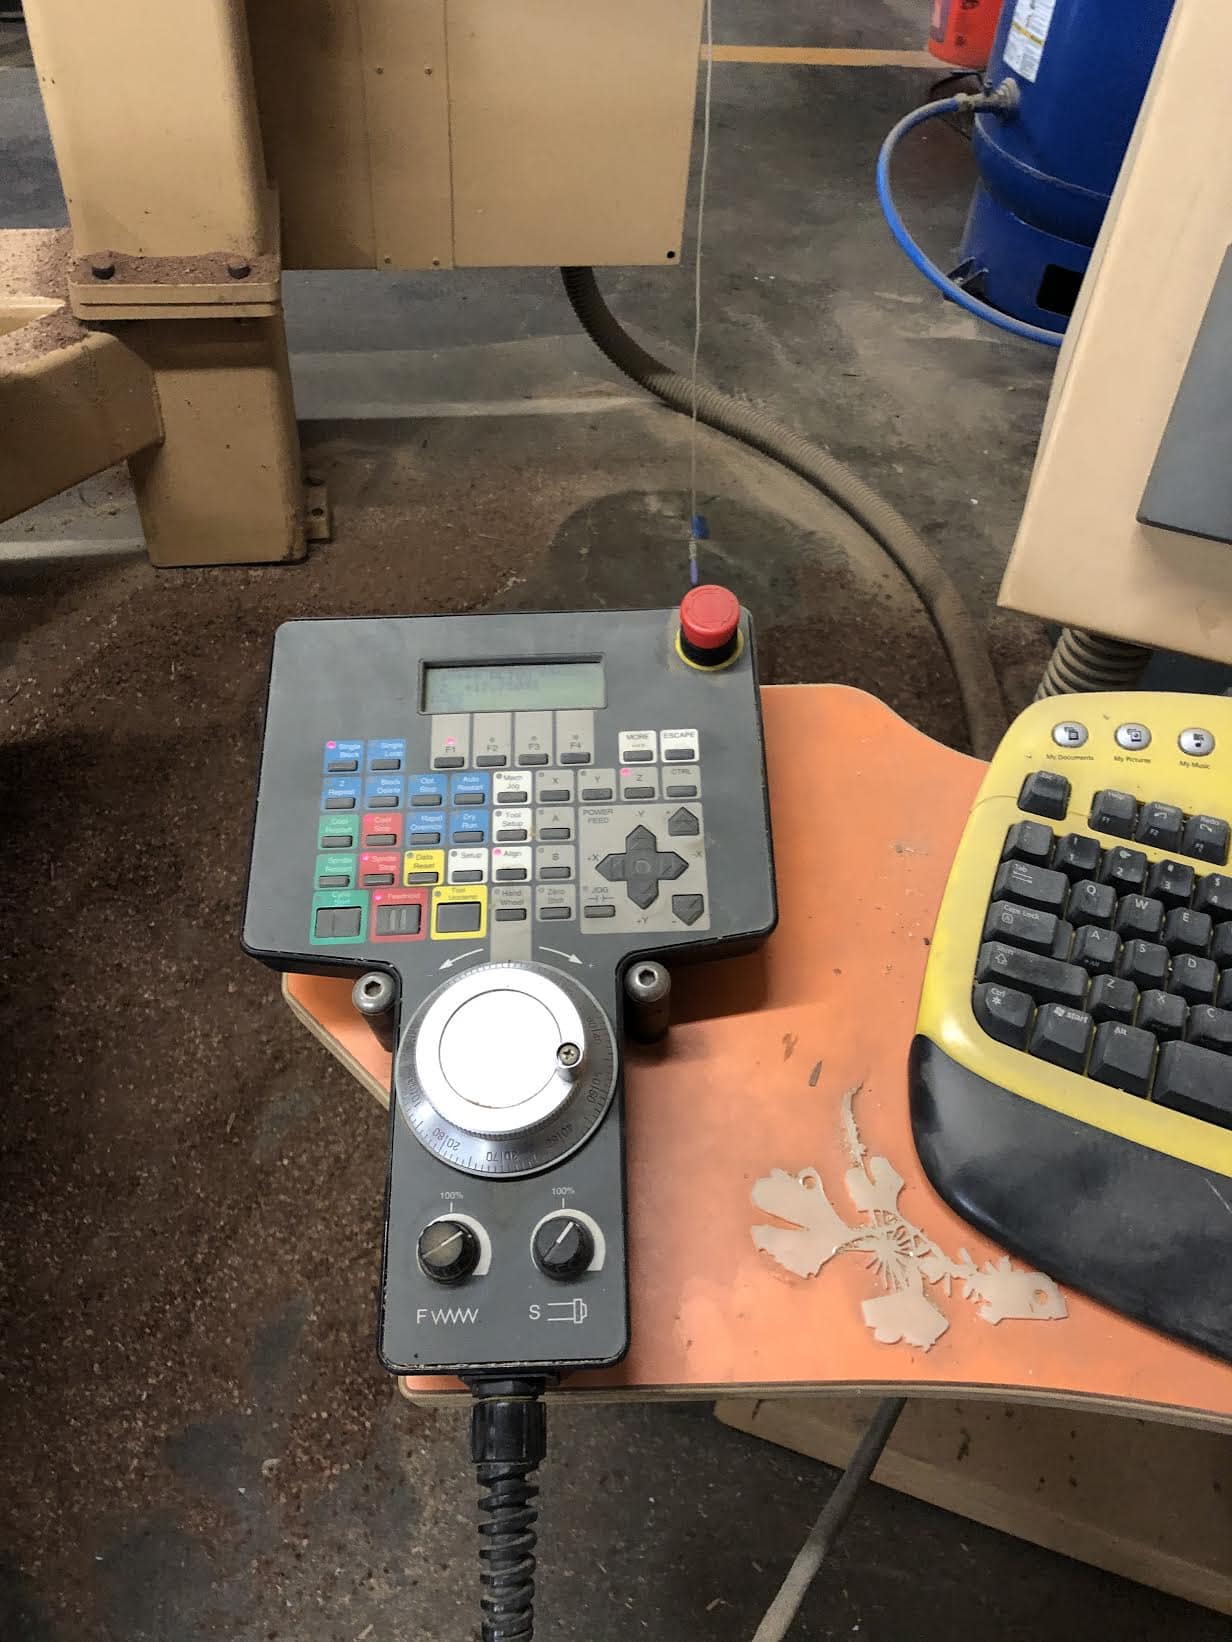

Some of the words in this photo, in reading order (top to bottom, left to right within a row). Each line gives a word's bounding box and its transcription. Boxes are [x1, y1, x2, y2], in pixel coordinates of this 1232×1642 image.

[663, 731, 696, 739] ESCAPE
[570, 742, 582, 750] F4
[1180, 760, 1190, 768] My
[1014, 863, 1028, 873] Tab
[1086, 884, 1096, 896] Q
[1136, 898, 1149, 910] W
[1182, 912, 1190, 922] E
[1090, 930, 1100, 940] A
[1140, 944, 1146, 952] S
[1188, 958, 1197, 968] D
[1106, 978, 1116, 989] Z
[1156, 992, 1166, 1004] X
[1206, 1007, 1215, 1018] C
[1065, 1012, 1089, 1024] start
[1114, 1026, 1128, 1036] Alt
[440, 1190, 464, 1200] 100%
[551, 1186, 576, 1196] 100%
[528, 1304, 541, 1320] S
